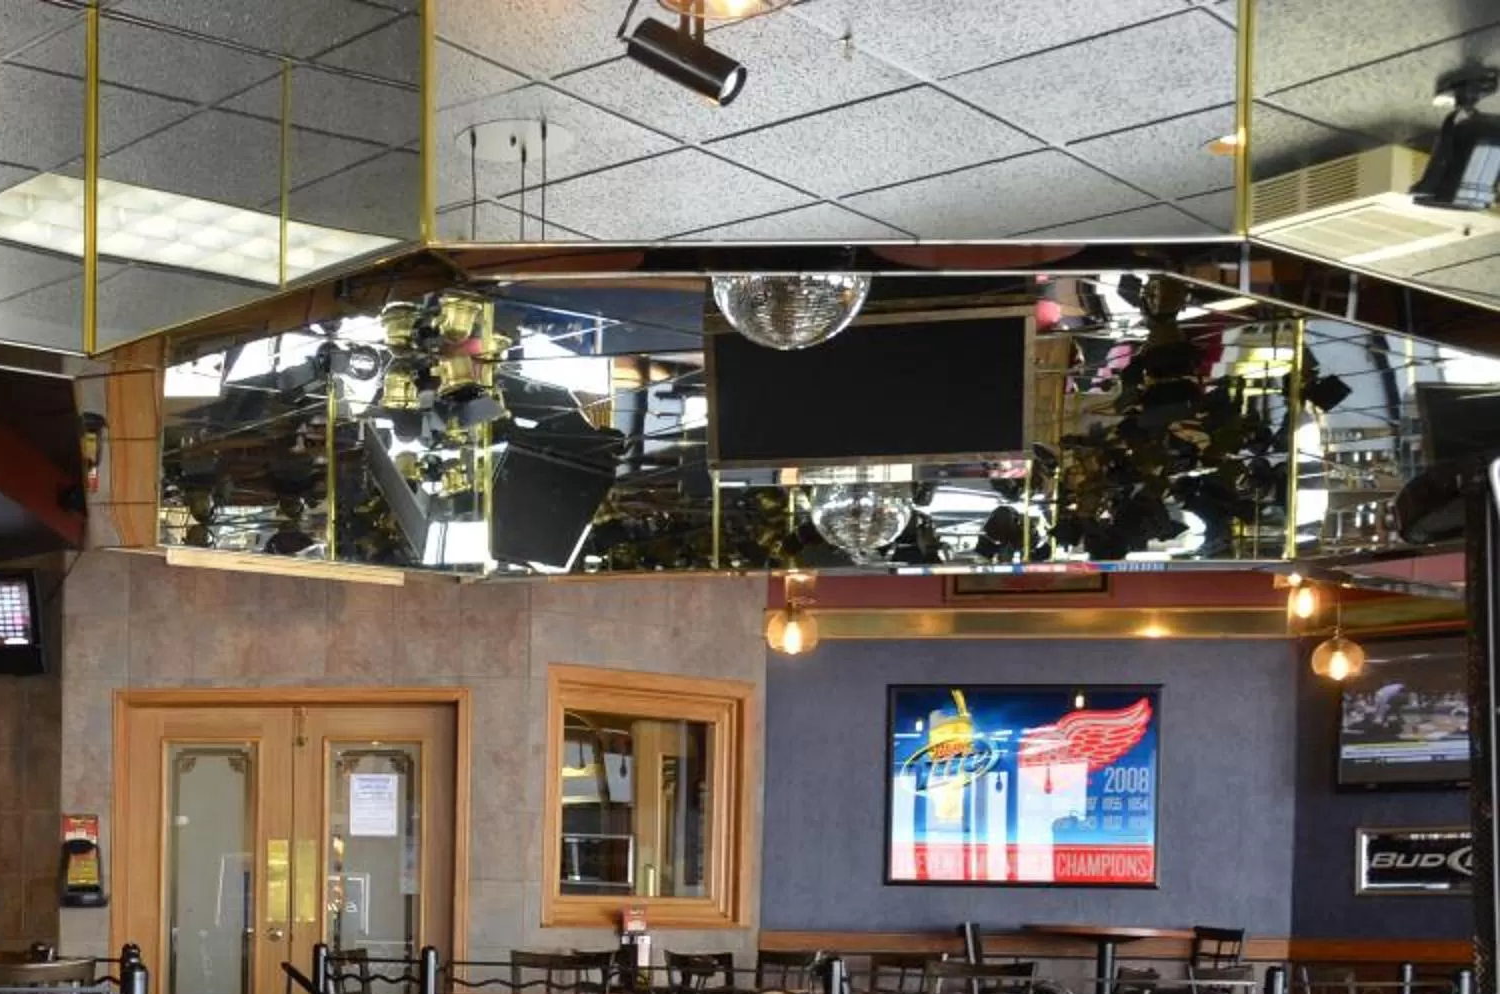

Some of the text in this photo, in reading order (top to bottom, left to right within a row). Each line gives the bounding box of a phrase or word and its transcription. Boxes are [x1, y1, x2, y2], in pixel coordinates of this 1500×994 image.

[1104, 767, 1148, 793] 2008
[1056, 853, 1148, 877] CHAMPIONS
[1371, 852, 1445, 868] BUD
